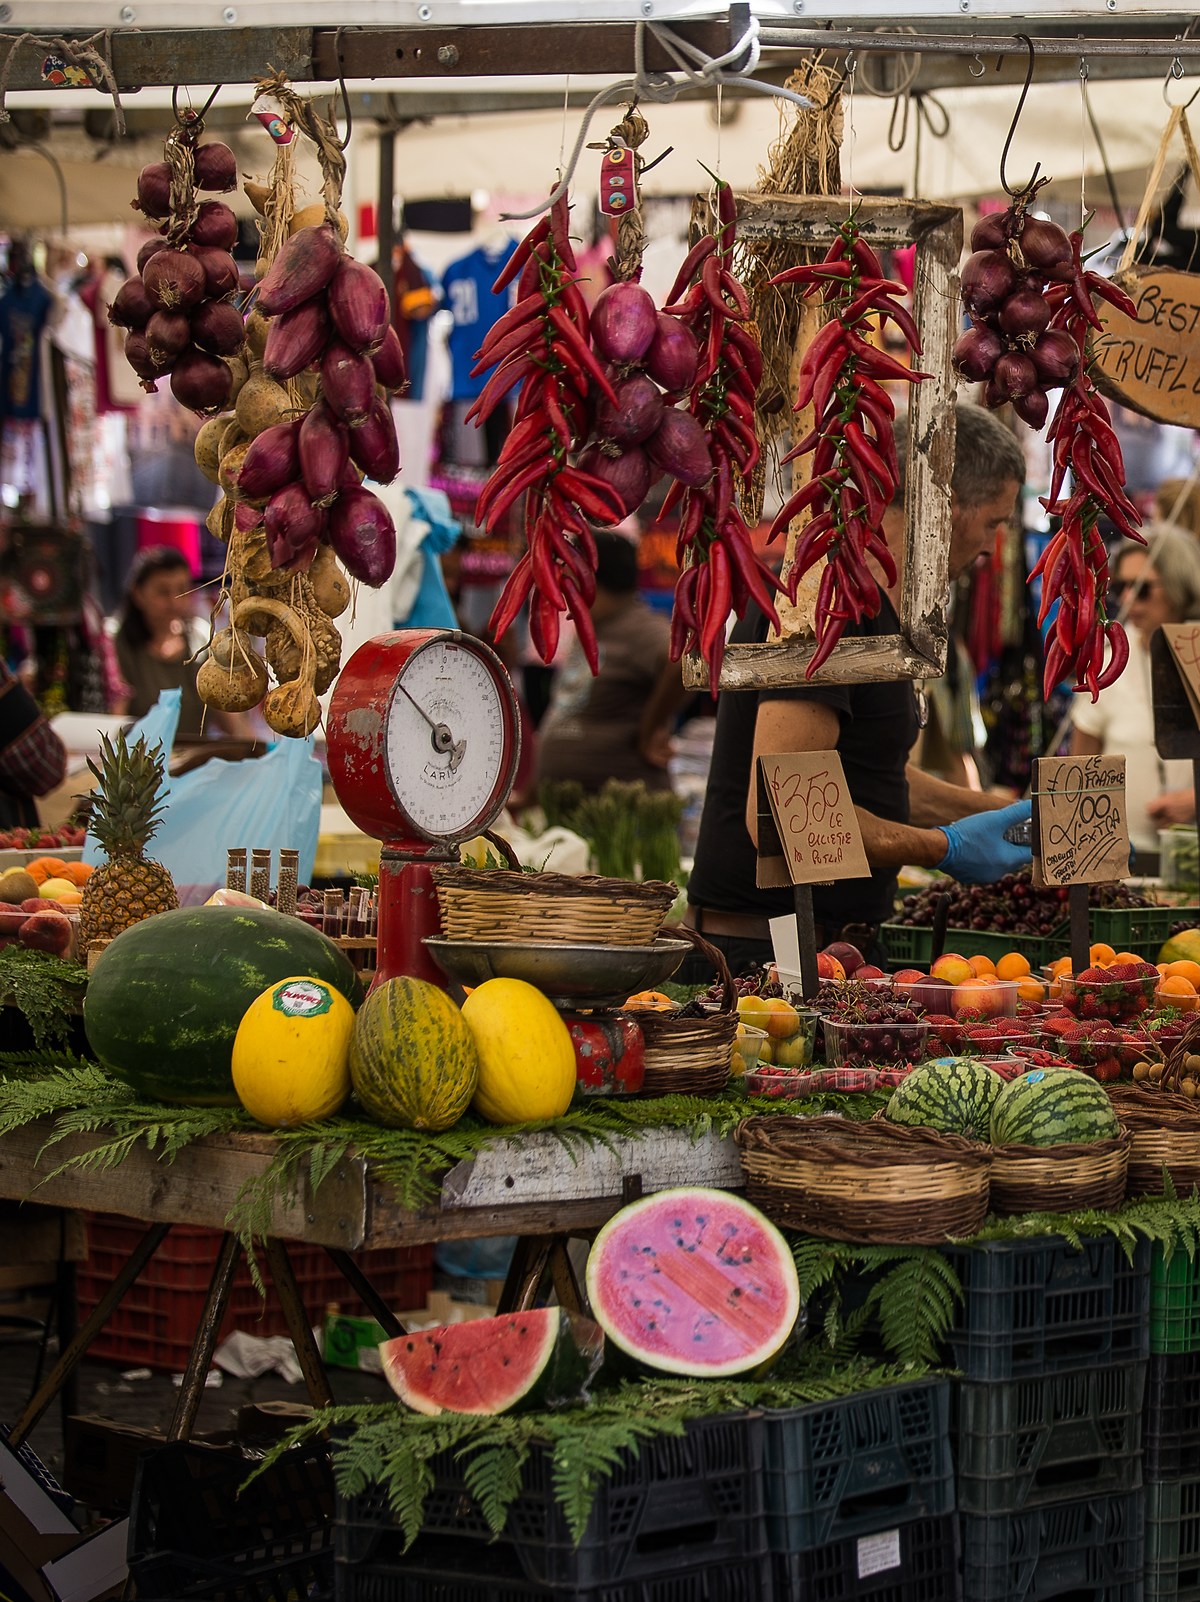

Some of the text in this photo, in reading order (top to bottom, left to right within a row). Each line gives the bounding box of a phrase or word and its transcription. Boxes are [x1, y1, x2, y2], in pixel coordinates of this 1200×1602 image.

[1085, 756, 1102, 770] LE
[829, 812, 844, 829] LE
[1077, 807, 1120, 851] EXTRA
